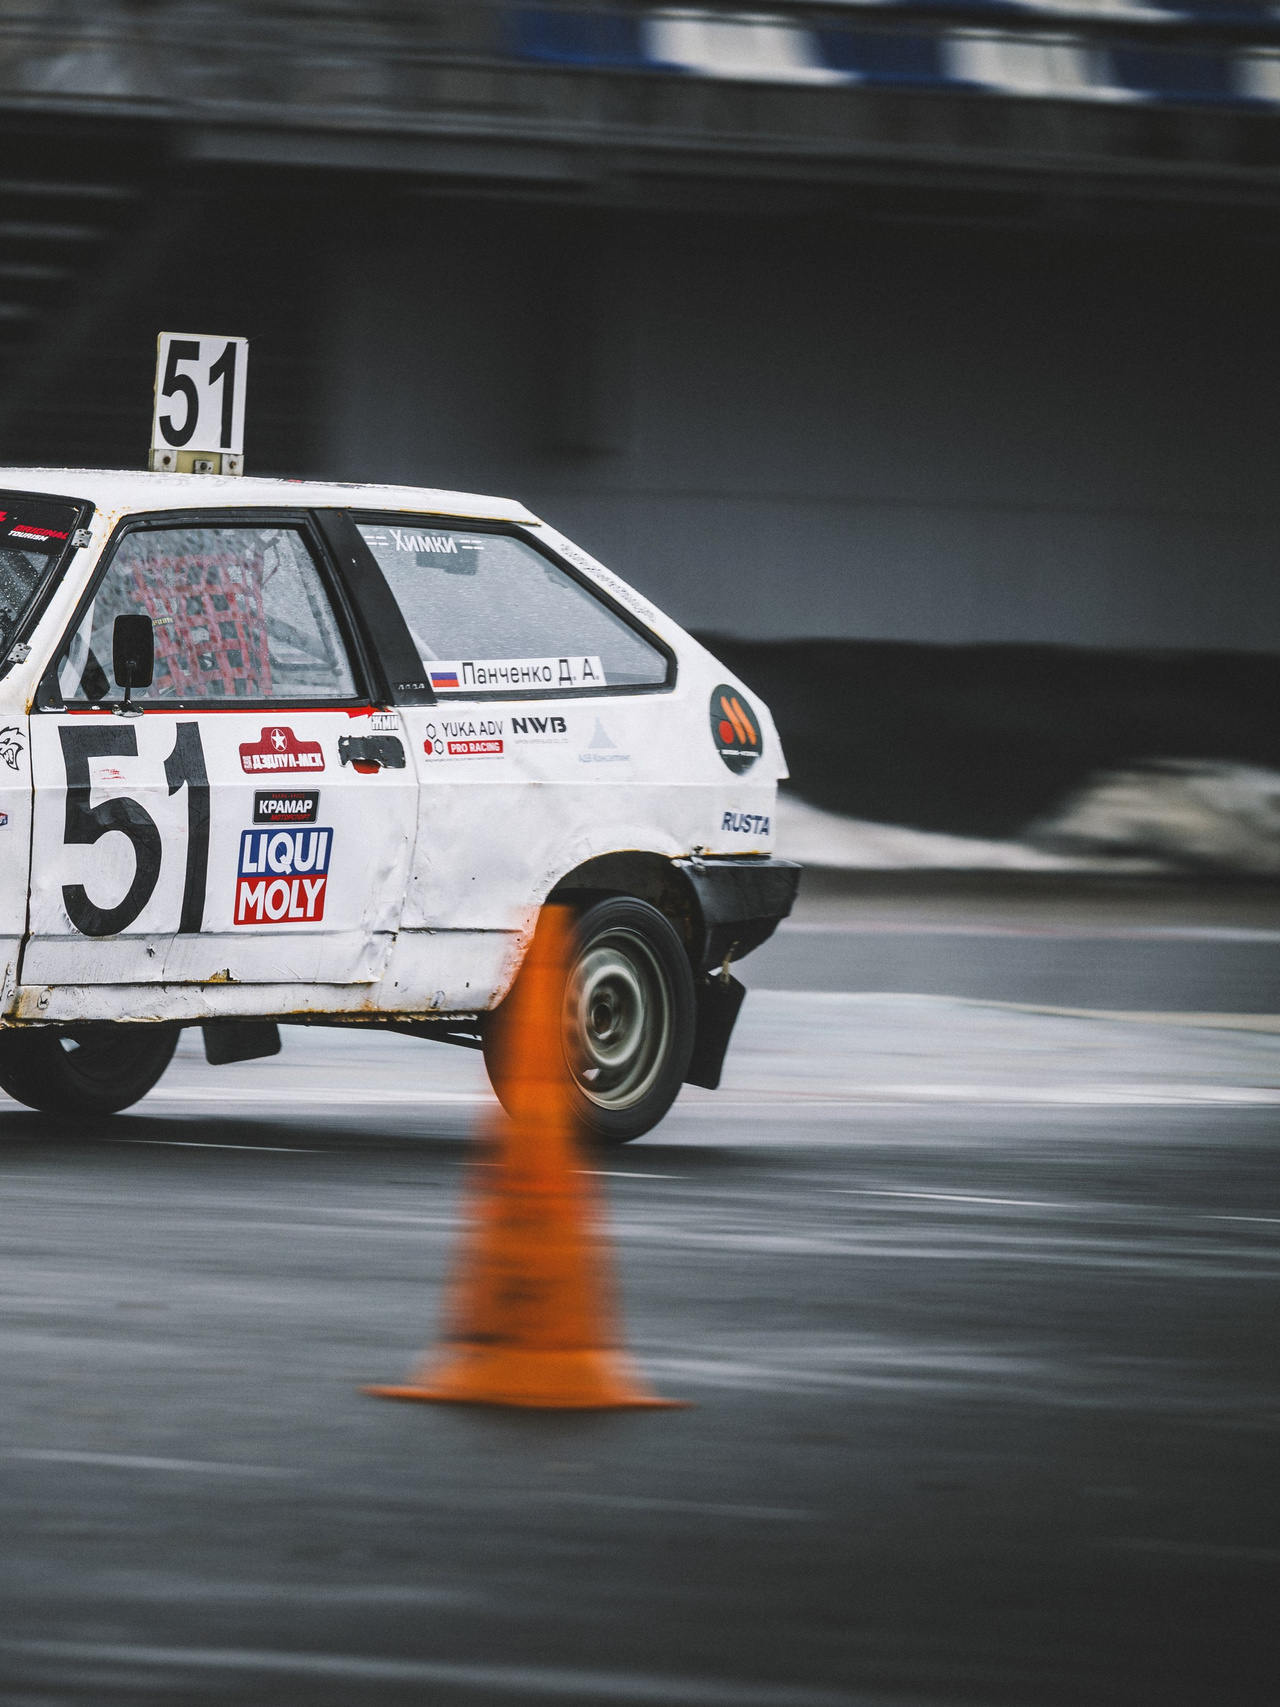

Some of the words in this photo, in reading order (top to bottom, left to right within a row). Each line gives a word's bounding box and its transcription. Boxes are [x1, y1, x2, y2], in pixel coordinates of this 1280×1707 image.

[159, 339, 238, 449] 51
[7, 530, 50, 543] TOURISM
[13, 524, 70, 540] ORIGINAL
[462, 661, 552, 685] Панченко
[558, 658, 577, 686] Д.
[582, 658, 600, 681] А.
[441, 722, 477, 737] YUKA
[479, 720, 503, 736] ADV
[511, 716, 567, 734] NWB
[450, 743, 468, 753] PRO
[468, 742, 500, 752] RACING
[258, 799, 313, 814] КРАМАР
[270, 813, 311, 821] МОТОРСПОРТ
[721, 811, 770, 836] RUSTA
[57, 721, 211, 937] 51
[241, 831, 328, 874] LIQUI
[237, 877, 325, 922] MOLY
